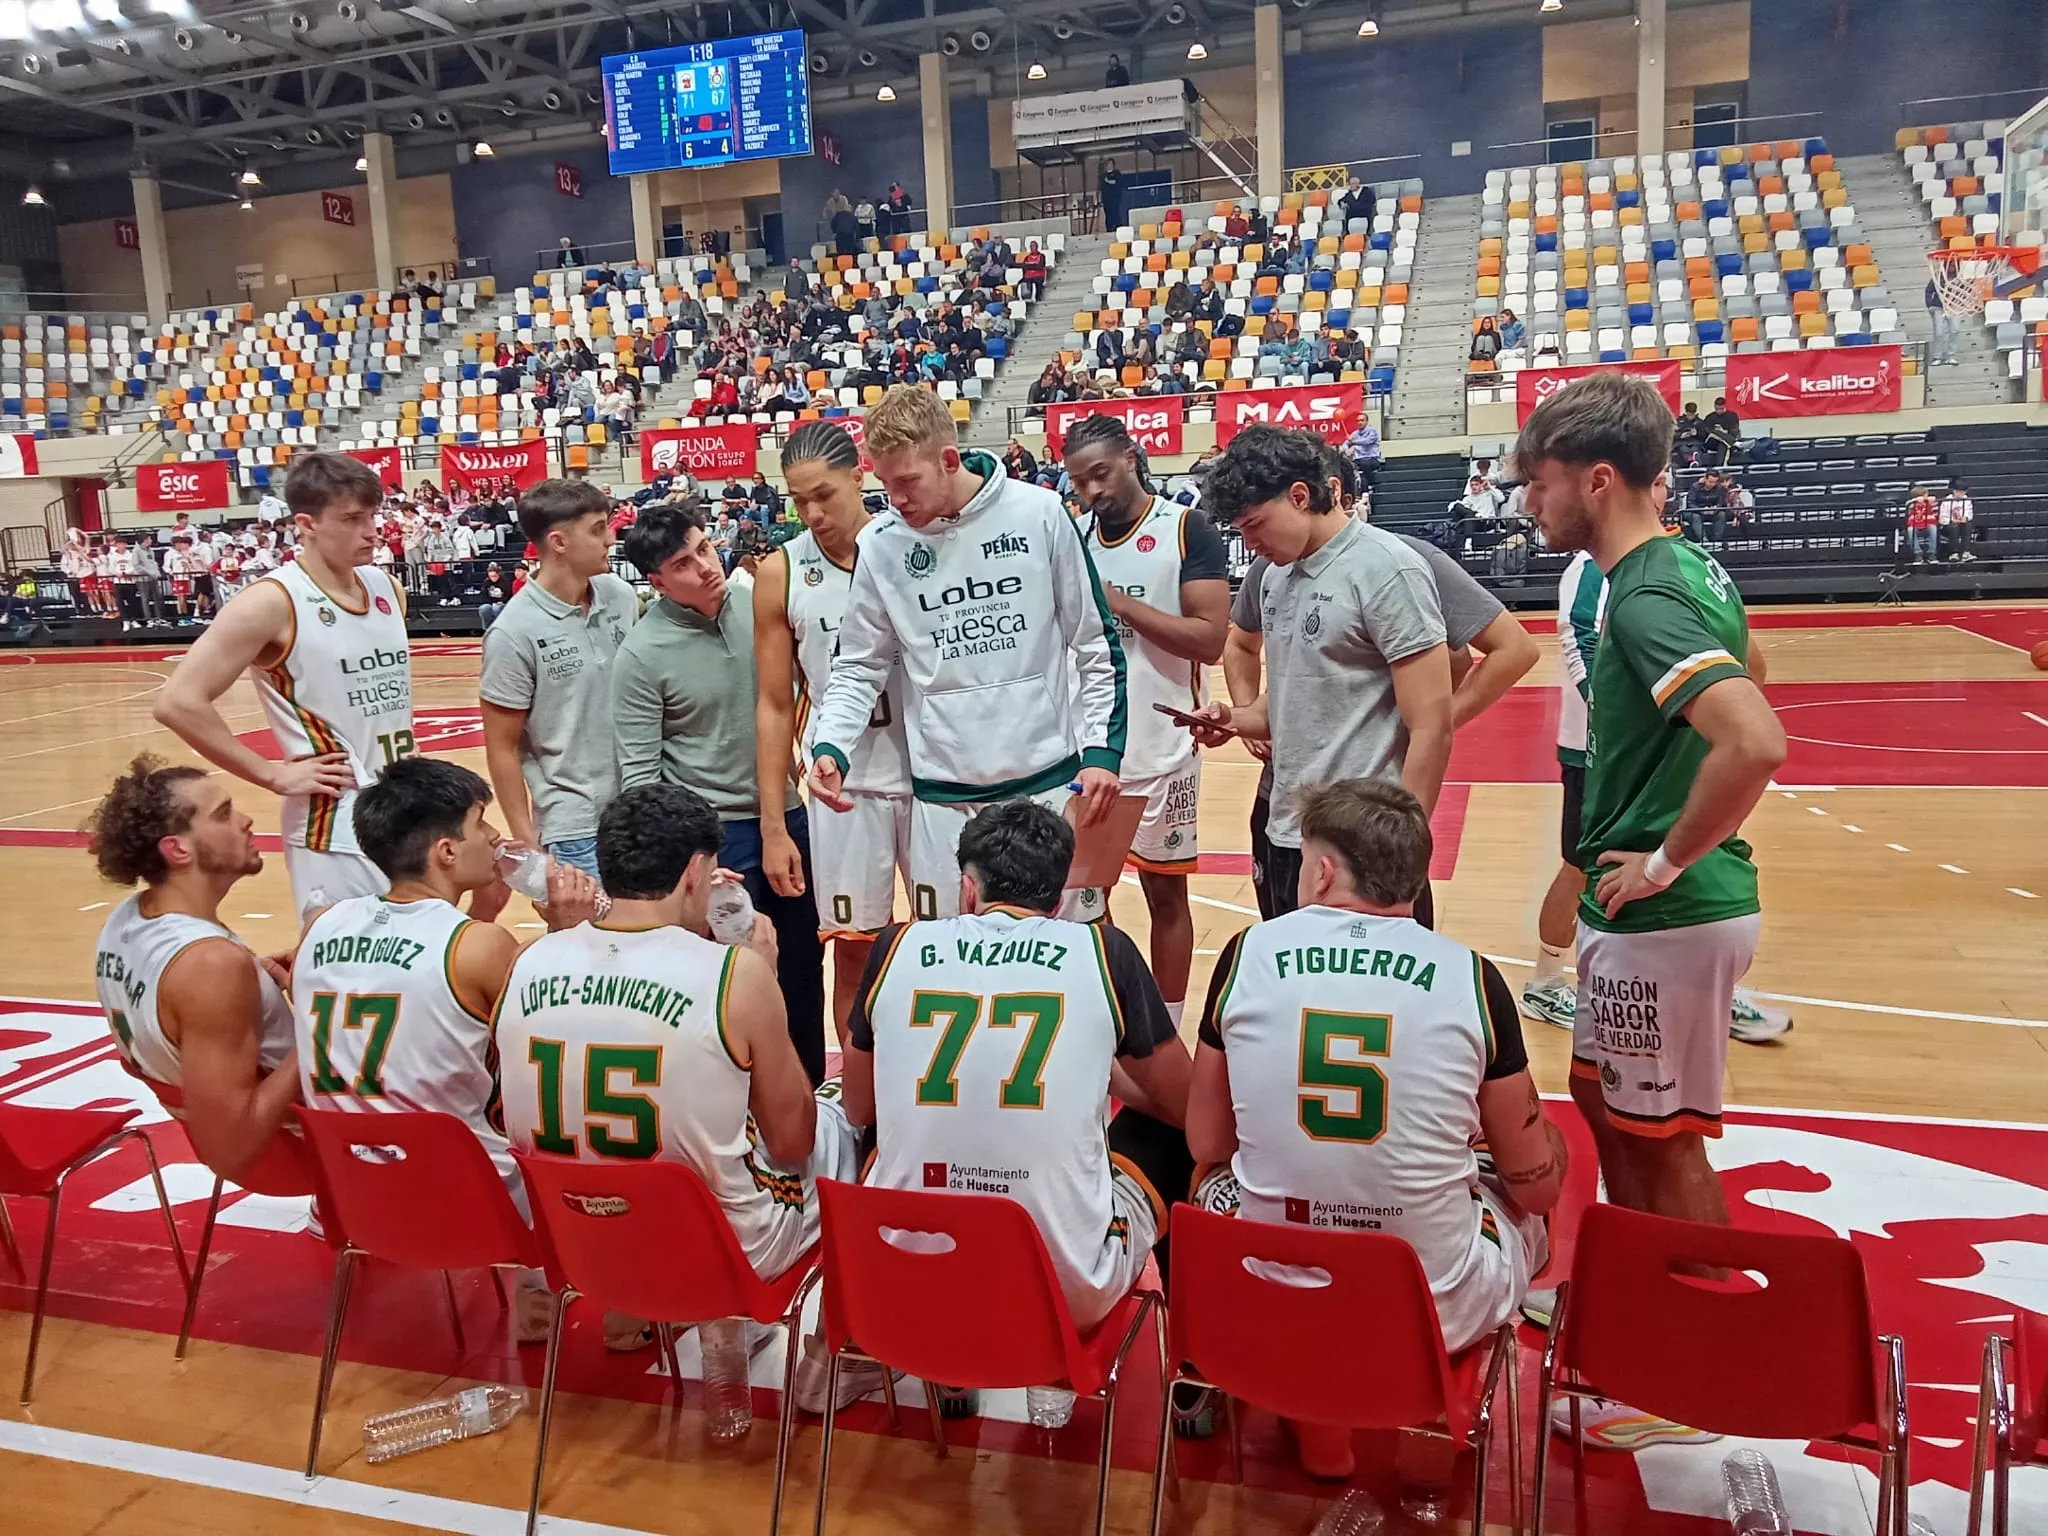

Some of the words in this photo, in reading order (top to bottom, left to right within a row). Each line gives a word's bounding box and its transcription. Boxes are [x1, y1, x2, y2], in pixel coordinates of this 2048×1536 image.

[689, 43, 713, 61] 1:18
[682, 94, 694, 109] 71
[712, 89, 725, 105] 67
[685, 143, 693, 158] 5
[721, 139, 728, 154] 4
[823, 136, 834, 158] 14
[558, 167, 571, 191] 13
[325, 196, 341, 220] 12
[119, 224, 133, 245] 11
[1801, 375, 1876, 392] kalibo
[1237, 397, 1340, 424] MAS
[457, 452, 528, 471] Silken
[717, 452, 745, 460] GRUPO
[718, 459, 744, 467] JORGE
[980, 535, 1029, 560] PEÑAS
[918, 576, 1022, 612] Lobe
[340, 648, 407, 674] Lobe
[833, 895, 852, 924] 0
[921, 943, 945, 968] G.
[956, 938, 1068, 972] VÁZQUEZ
[1275, 946, 1437, 992] FIGUEROA
[1592, 975, 1658, 1003] ARAGÓN
[520, 974, 694, 1029] LÓPEZ-SANVICENTE
[1591, 997, 1660, 1032] SABOR
[309, 990, 402, 1099] 17
[909, 989, 1065, 1111] 77
[1594, 1025, 1606, 1044] DE
[1609, 1029, 1662, 1051] VERDAD
[1297, 1007, 1393, 1145] 5
[528, 1036, 663, 1161] 15
[950, 1162, 1029, 1180] Ayuntamiento
[950, 1177, 963, 1189] de
[966, 1179, 1009, 1193] Huesca
[1313, 1200, 1403, 1216] Ayuntamiento
[1312, 1215, 1328, 1226] de
[1332, 1216, 1382, 1229] Huesca
